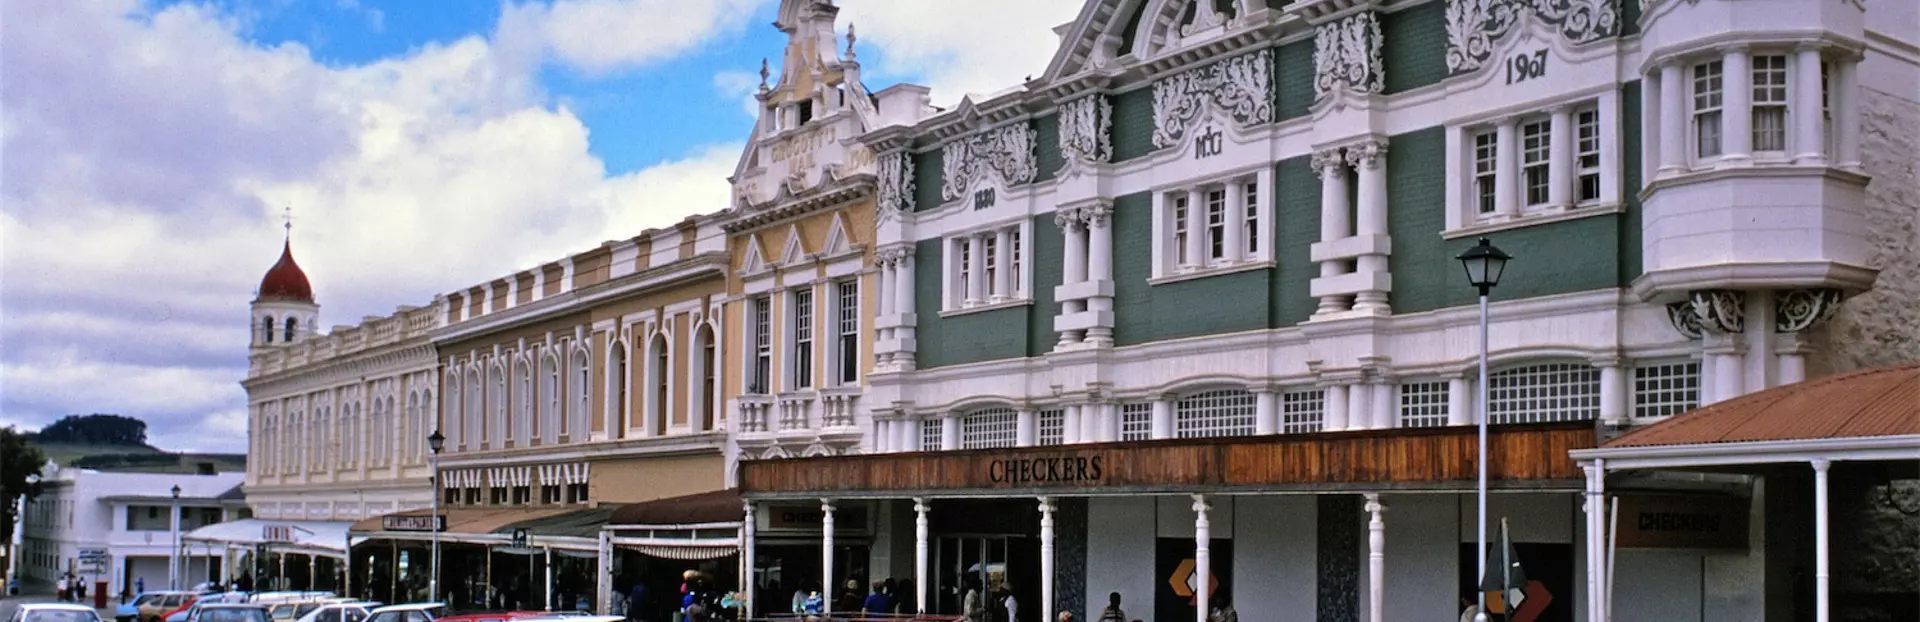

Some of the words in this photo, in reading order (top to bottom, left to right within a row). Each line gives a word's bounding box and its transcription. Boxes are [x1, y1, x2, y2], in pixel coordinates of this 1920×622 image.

[1505, 47, 1549, 86] 1907
[974, 187, 996, 213] 1880
[989, 455, 1102, 483] CHECKERS
